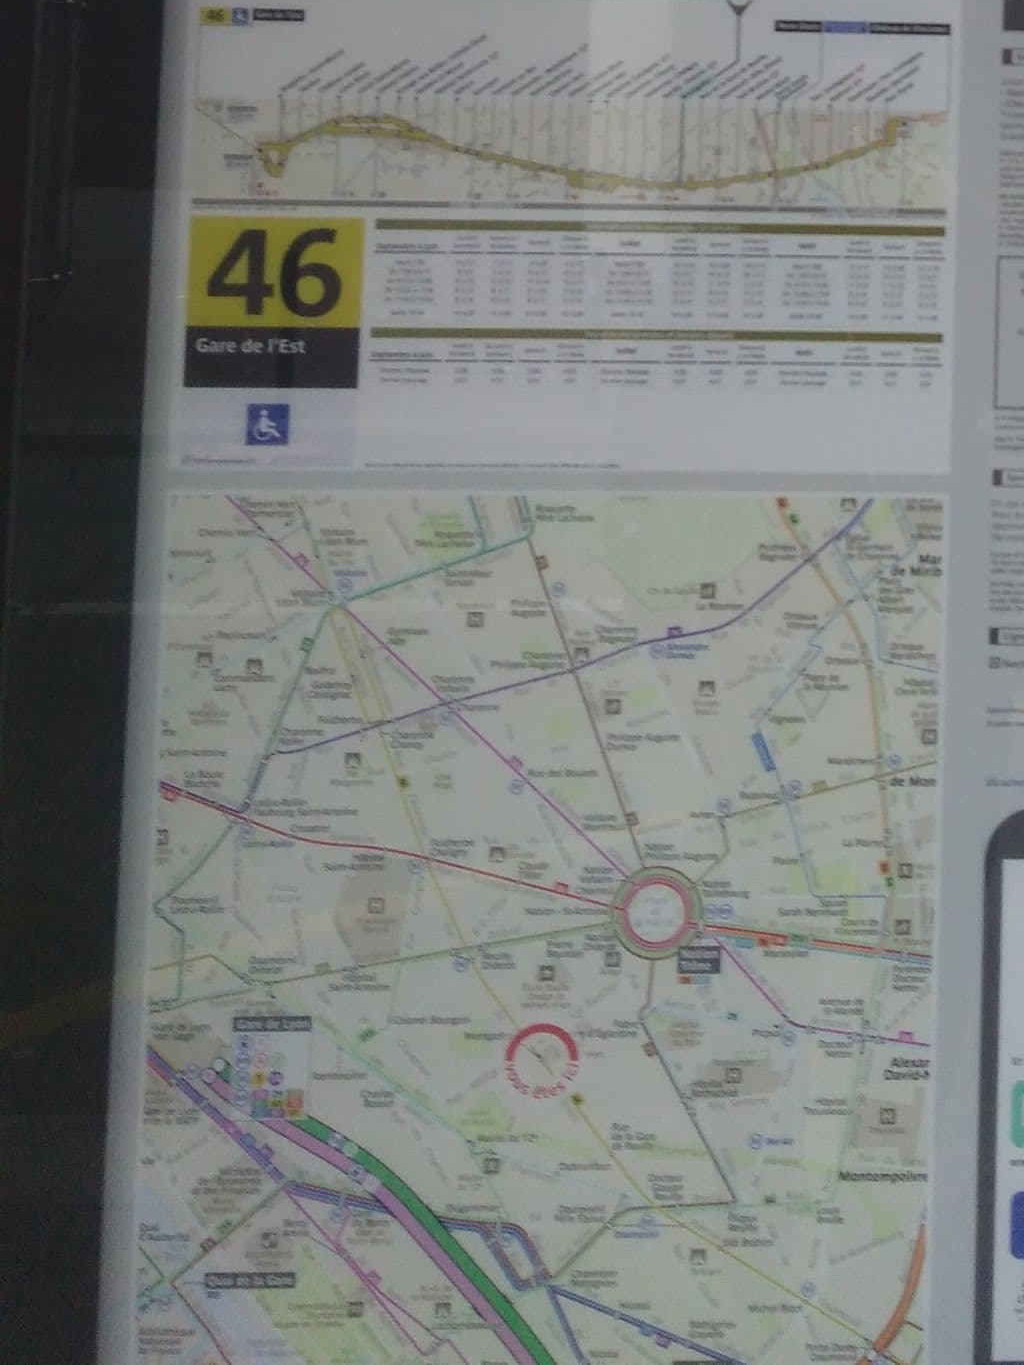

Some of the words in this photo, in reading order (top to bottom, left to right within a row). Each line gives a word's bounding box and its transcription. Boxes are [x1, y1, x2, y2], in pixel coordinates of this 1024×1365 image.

[207, 228, 341, 318] 46
[196, 337, 238, 354] Gare
[241, 338, 265, 354] de
[268, 338, 306, 355] l'Est
